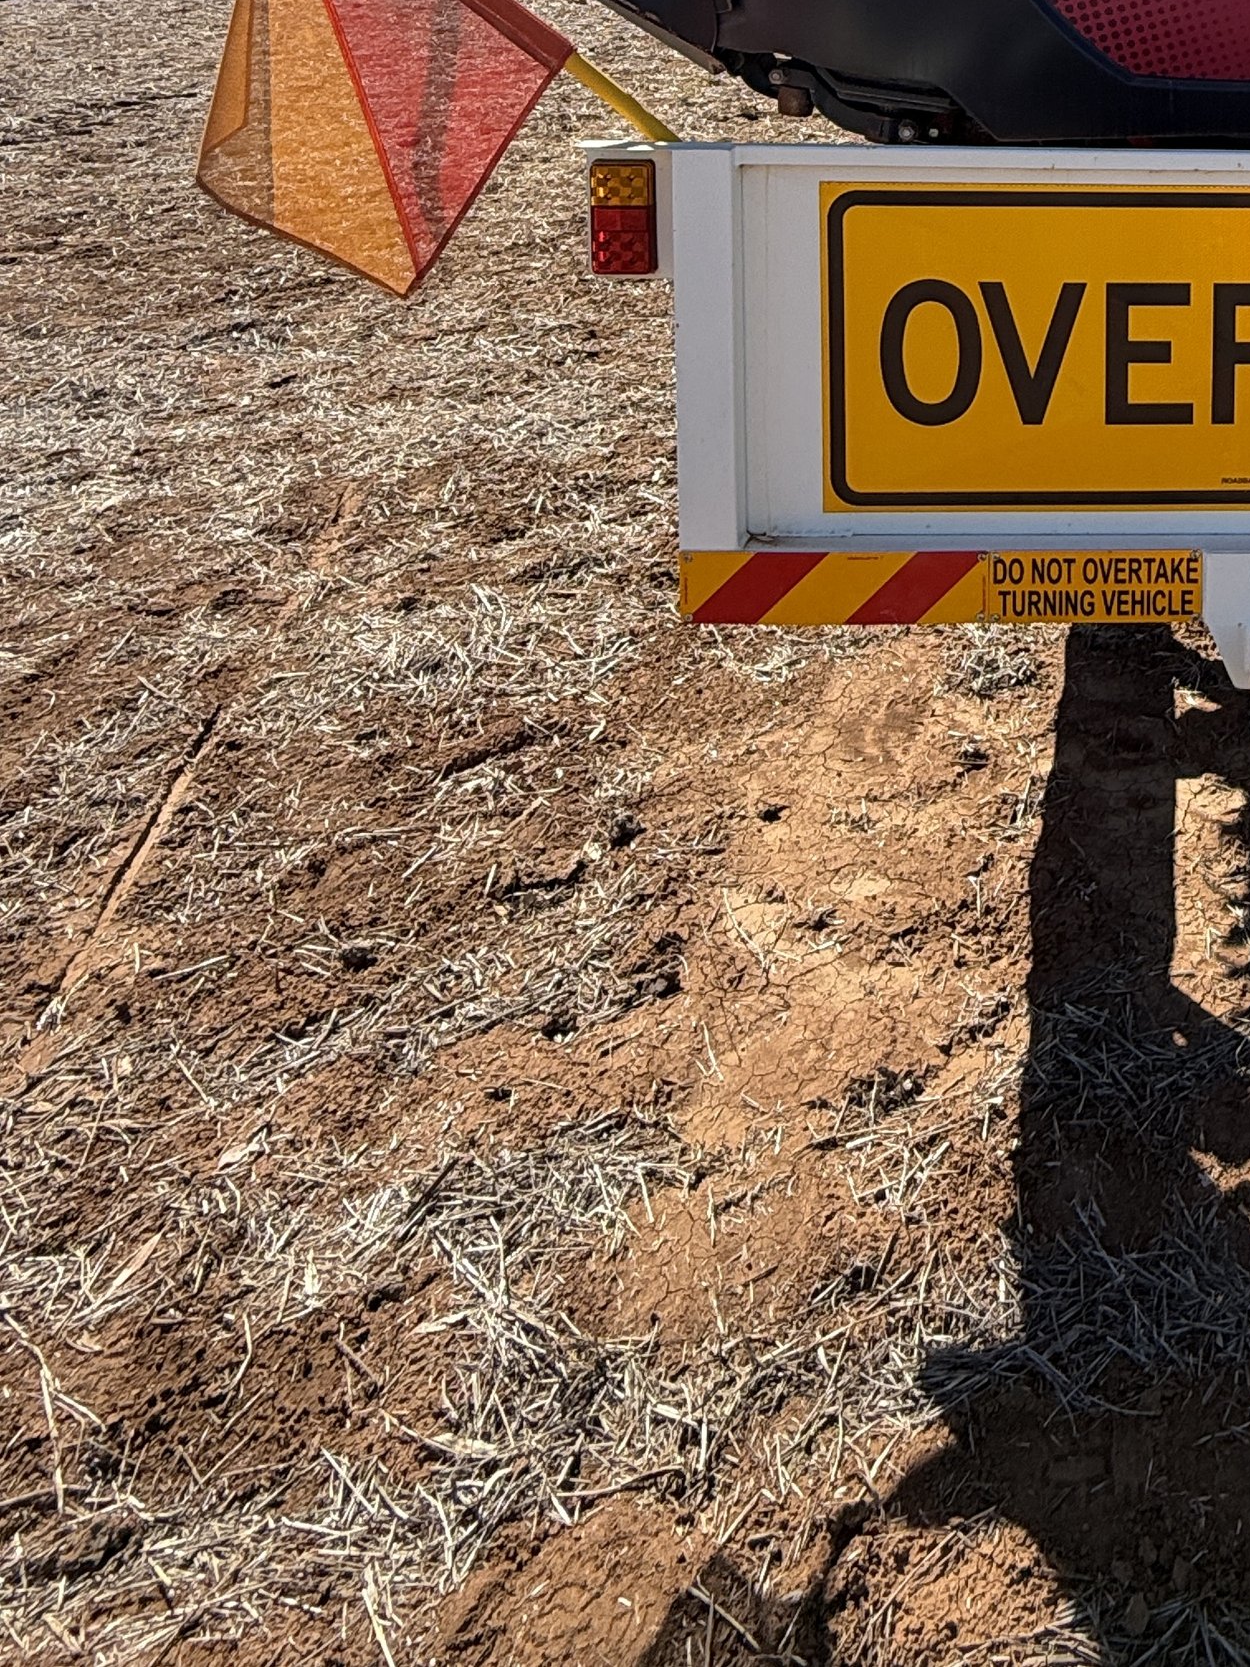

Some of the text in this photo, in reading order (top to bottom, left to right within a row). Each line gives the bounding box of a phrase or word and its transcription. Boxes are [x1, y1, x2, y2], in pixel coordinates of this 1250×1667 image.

[993, 557, 1199, 585] DO NOT OVERTAKE
[998, 589, 1095, 618] TURNING
[1102, 589, 1194, 617] VEHICLE
